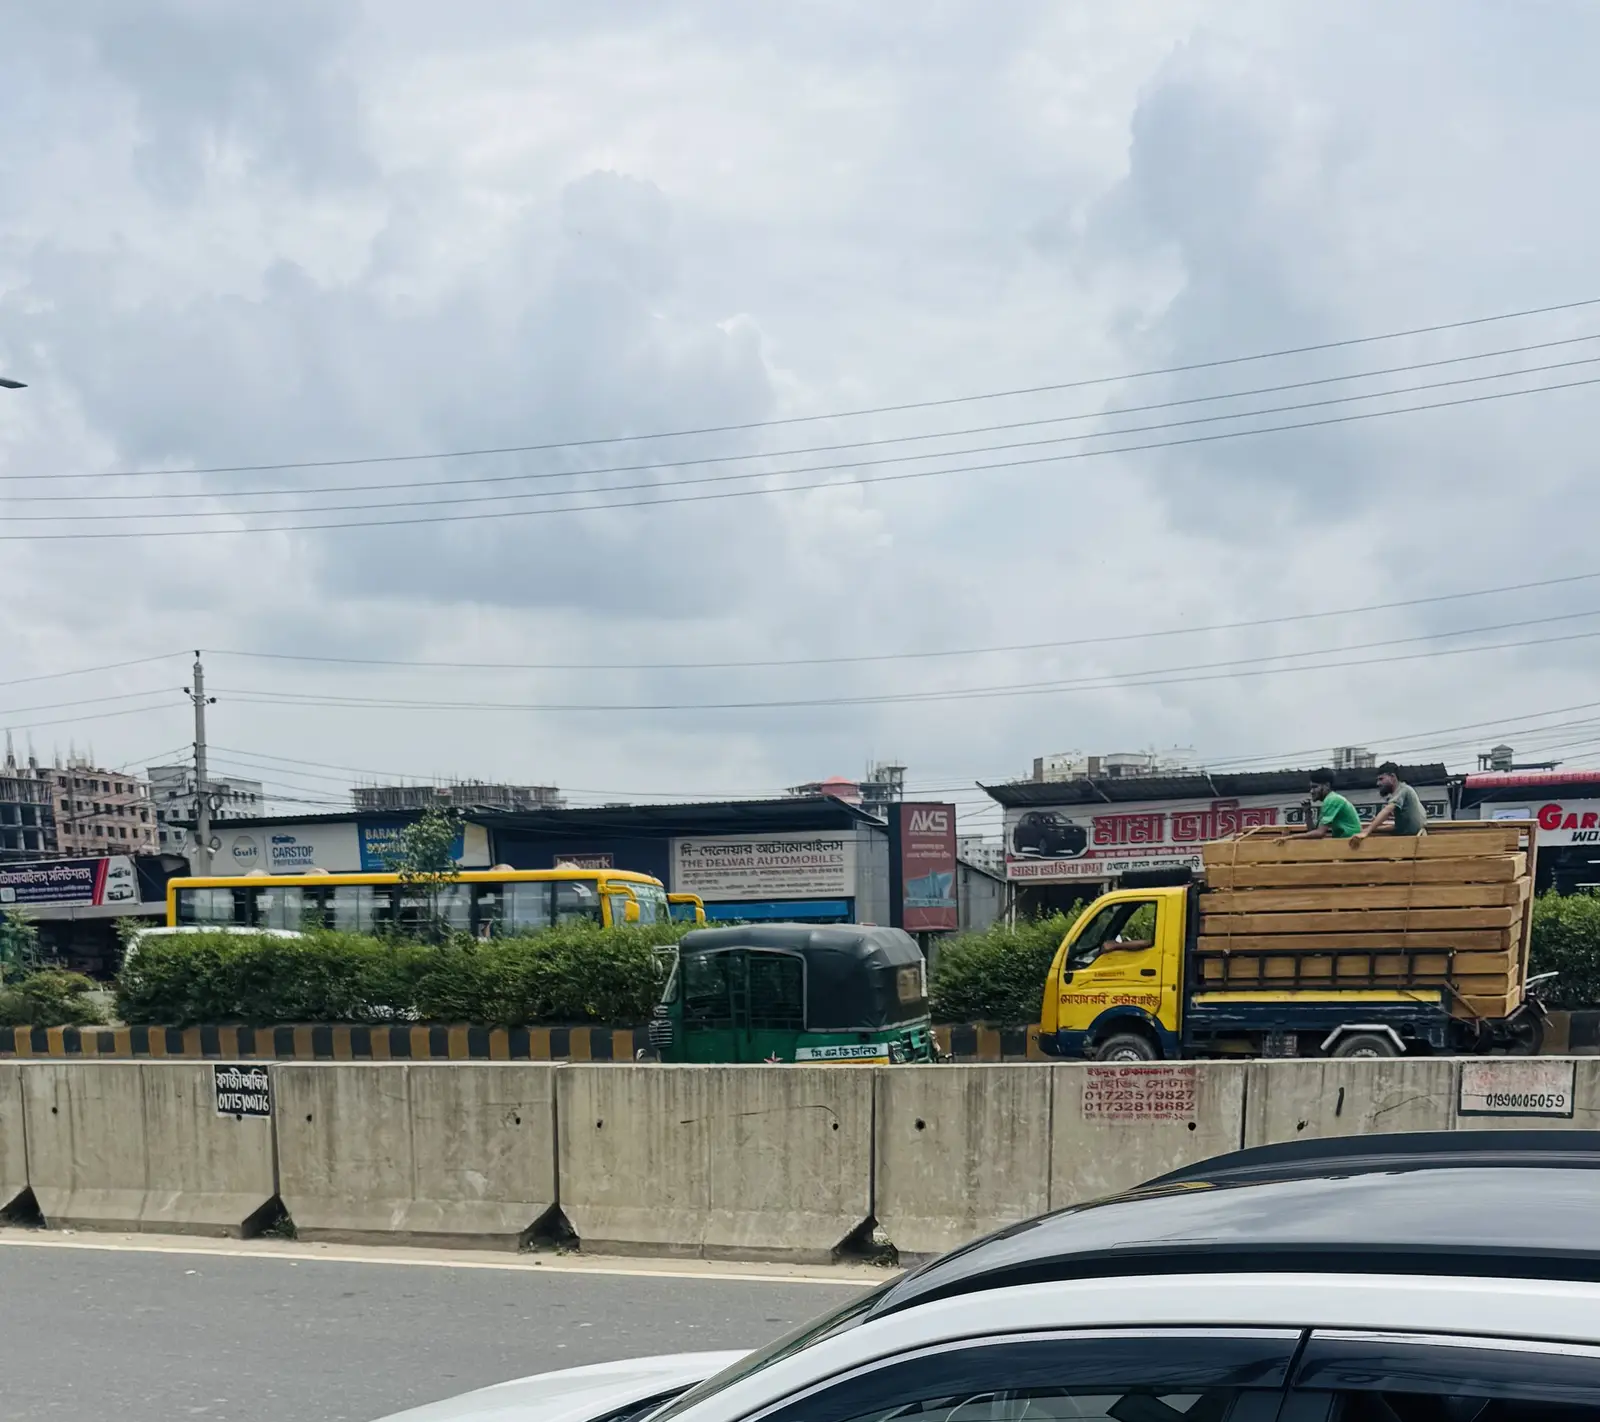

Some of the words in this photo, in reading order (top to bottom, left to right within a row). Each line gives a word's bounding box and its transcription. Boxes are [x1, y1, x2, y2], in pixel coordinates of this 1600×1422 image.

[909, 810, 948, 832] AKS
[1092, 813, 1166, 845] মামা
[1171, 801, 1278, 842] ভাগিনা
[1538, 803, 1600, 831] GAR
[1571, 831, 1600, 842] WO
[233, 847, 258, 857] Gulf
[272, 846, 314, 859] CARSTOP
[681, 859, 703, 869] THE
[706, 857, 754, 868] DELWAR
[757, 854, 844, 866] AUTOMOBILES
[1085, 1102, 1195, 1112] 01732818682
